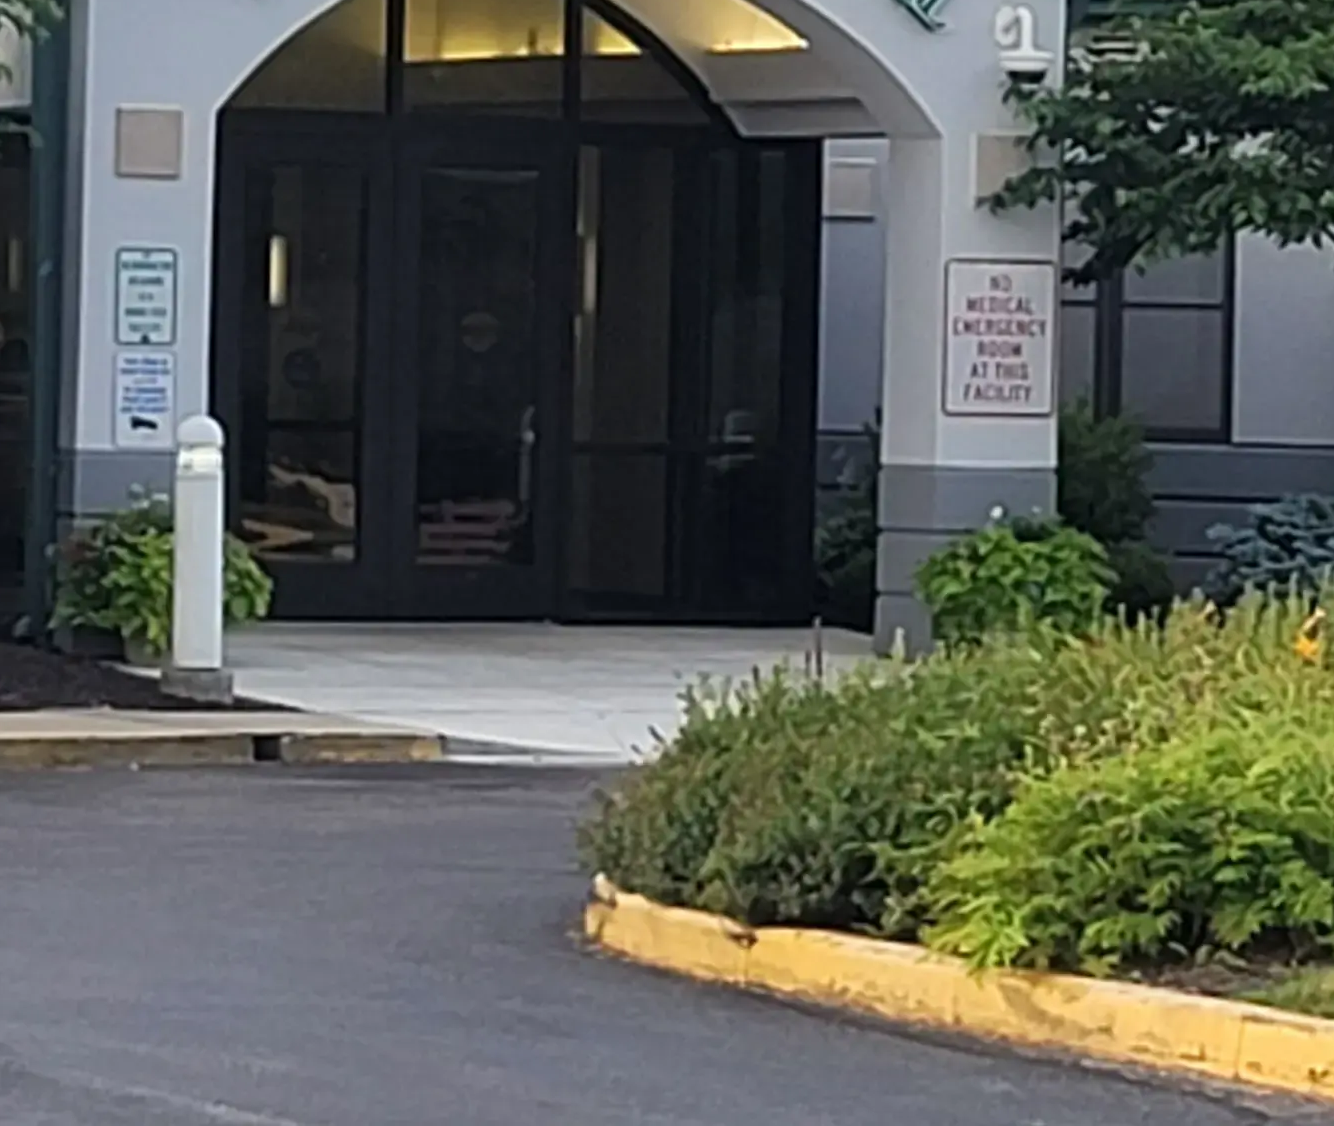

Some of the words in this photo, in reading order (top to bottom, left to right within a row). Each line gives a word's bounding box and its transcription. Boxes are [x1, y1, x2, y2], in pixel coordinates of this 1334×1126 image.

[989, 274, 1013, 292] NO
[966, 296, 1034, 315] MEDICAL
[952, 317, 1047, 337] EMERGENCY
[977, 340, 1023, 358] ROOM
[970, 361, 988, 379] AT
[995, 361, 1030, 380] THIS
[963, 383, 1033, 403] FACILITY
